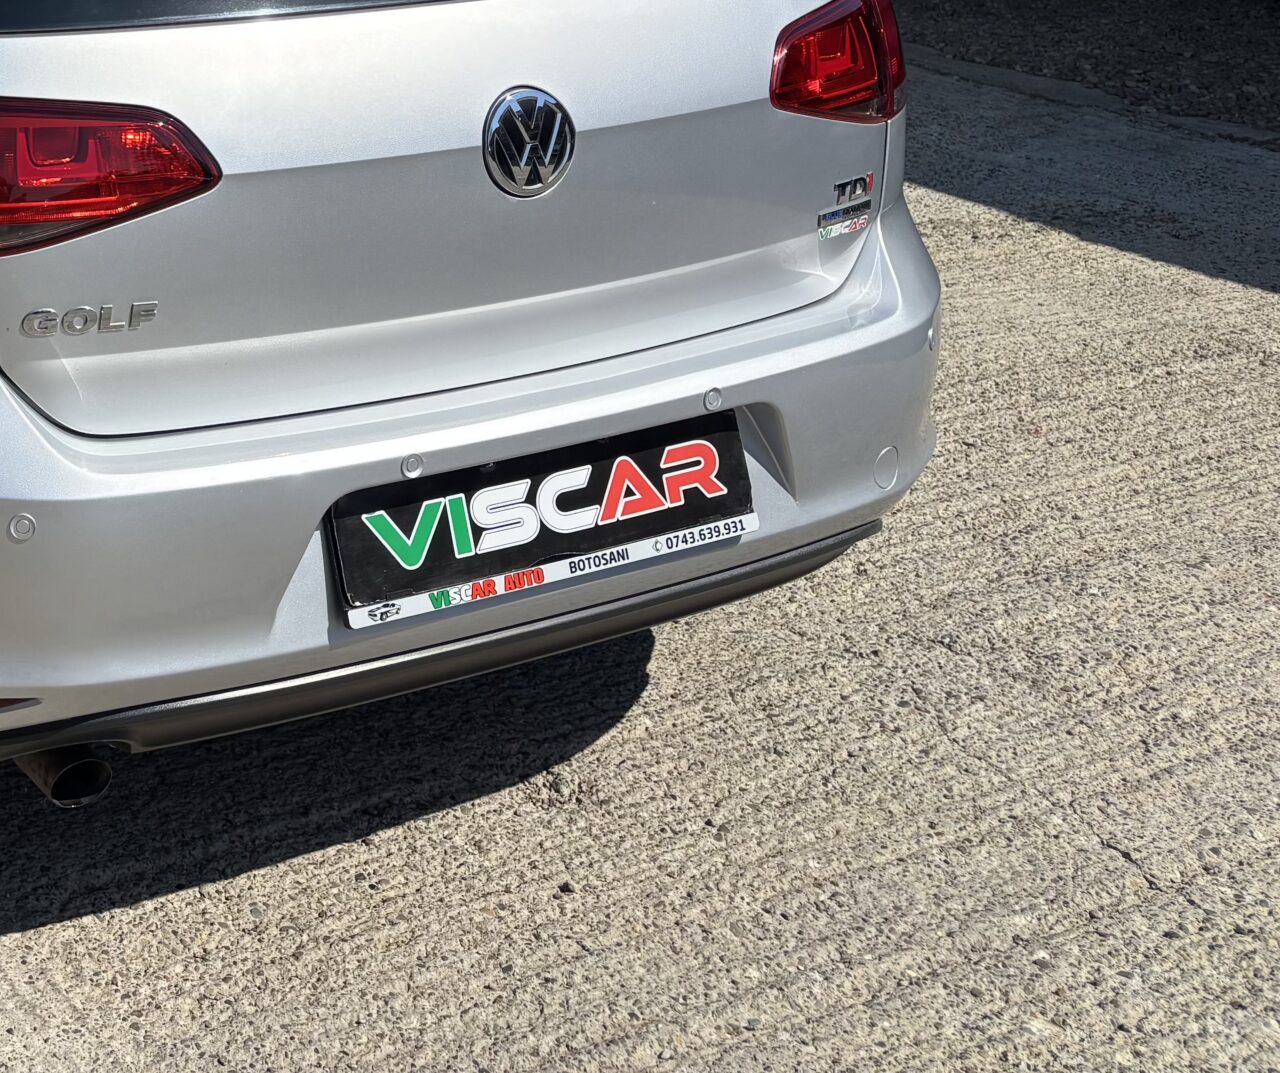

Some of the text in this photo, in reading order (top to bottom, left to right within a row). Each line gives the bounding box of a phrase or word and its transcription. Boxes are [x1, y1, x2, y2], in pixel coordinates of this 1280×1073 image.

[833, 171, 874, 205] TDI
[818, 215, 869, 240] VISCAR
[21, 300, 159, 338] GOLF
[361, 439, 728, 571] VISCAR
[569, 519, 747, 574] BOTOSANI 0743.639.931
[428, 567, 545, 610] VISCAR AUTO
